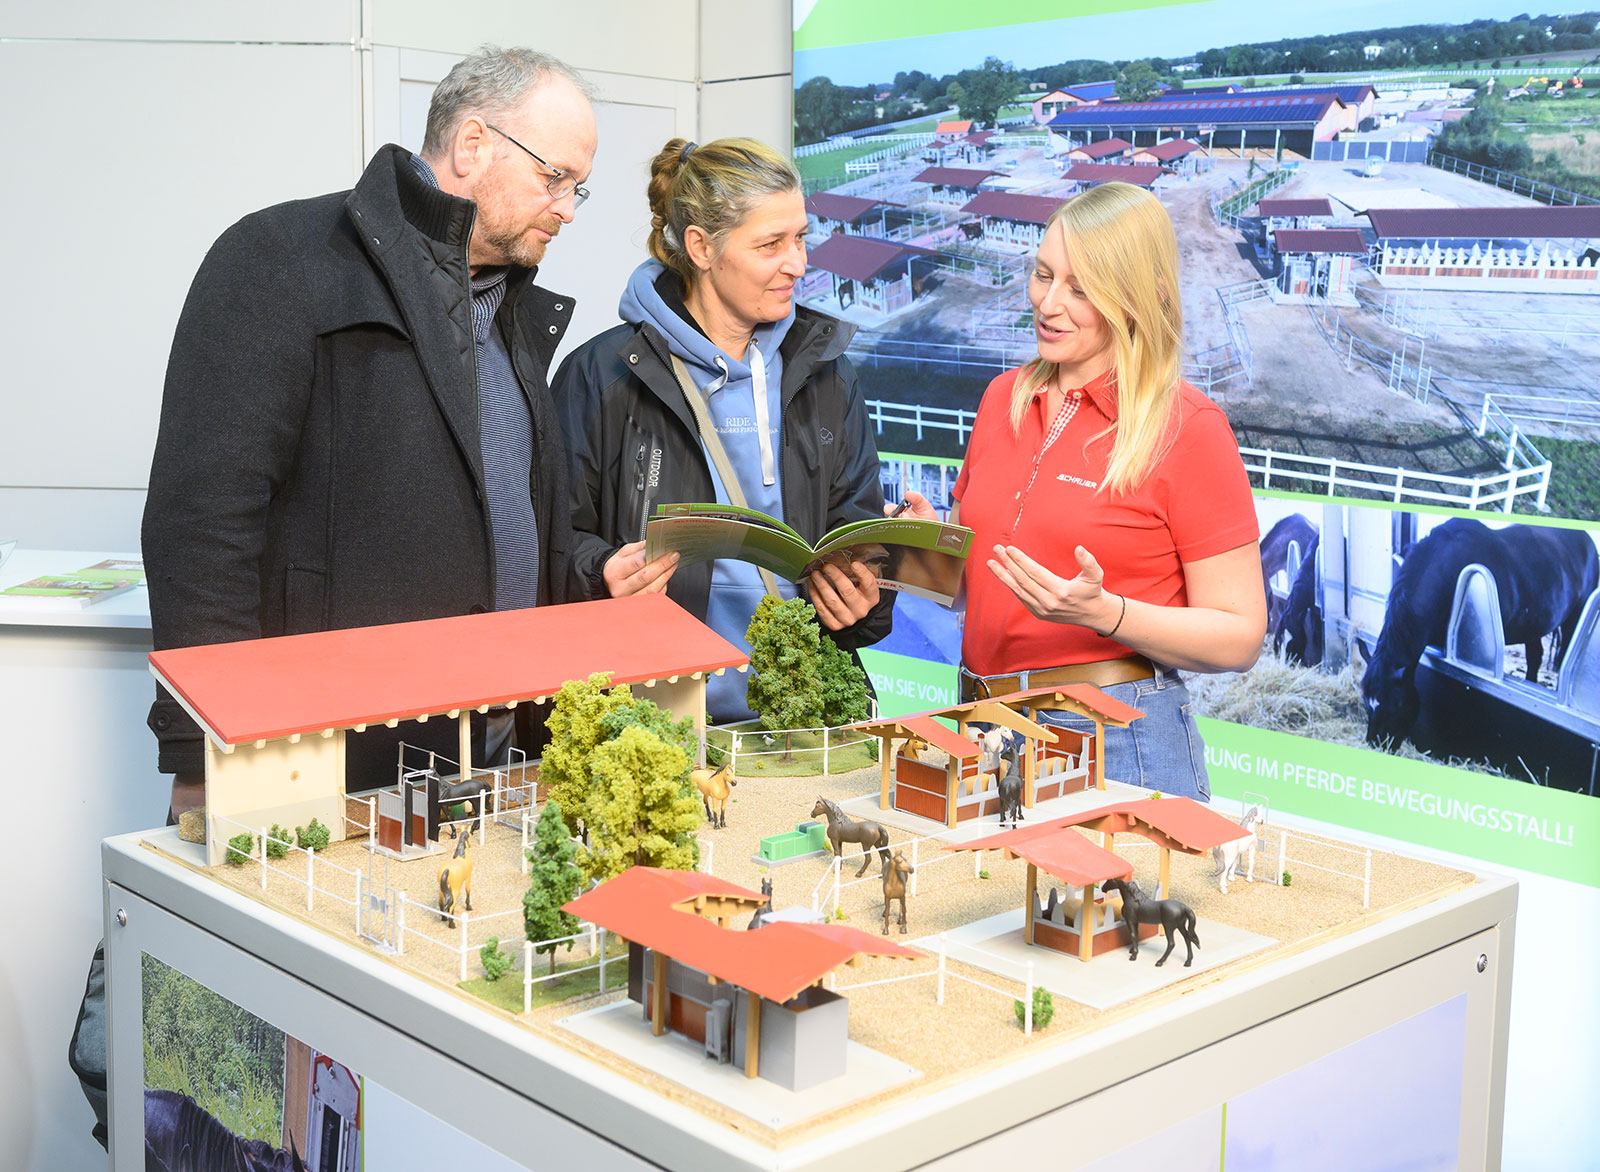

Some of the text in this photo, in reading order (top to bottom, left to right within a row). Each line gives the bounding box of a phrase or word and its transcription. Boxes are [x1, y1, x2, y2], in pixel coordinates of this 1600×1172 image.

[725, 416, 751, 427] RIDE
[648, 448, 663, 487] OUTDOOR
[896, 678, 915, 698] SIE
[917, 682, 948, 706] VON
[1256, 756, 1279, 780] IM
[1283, 762, 1357, 798] PFERDE
[1361, 779, 1574, 847] BEWEGUNGSSTALL!
